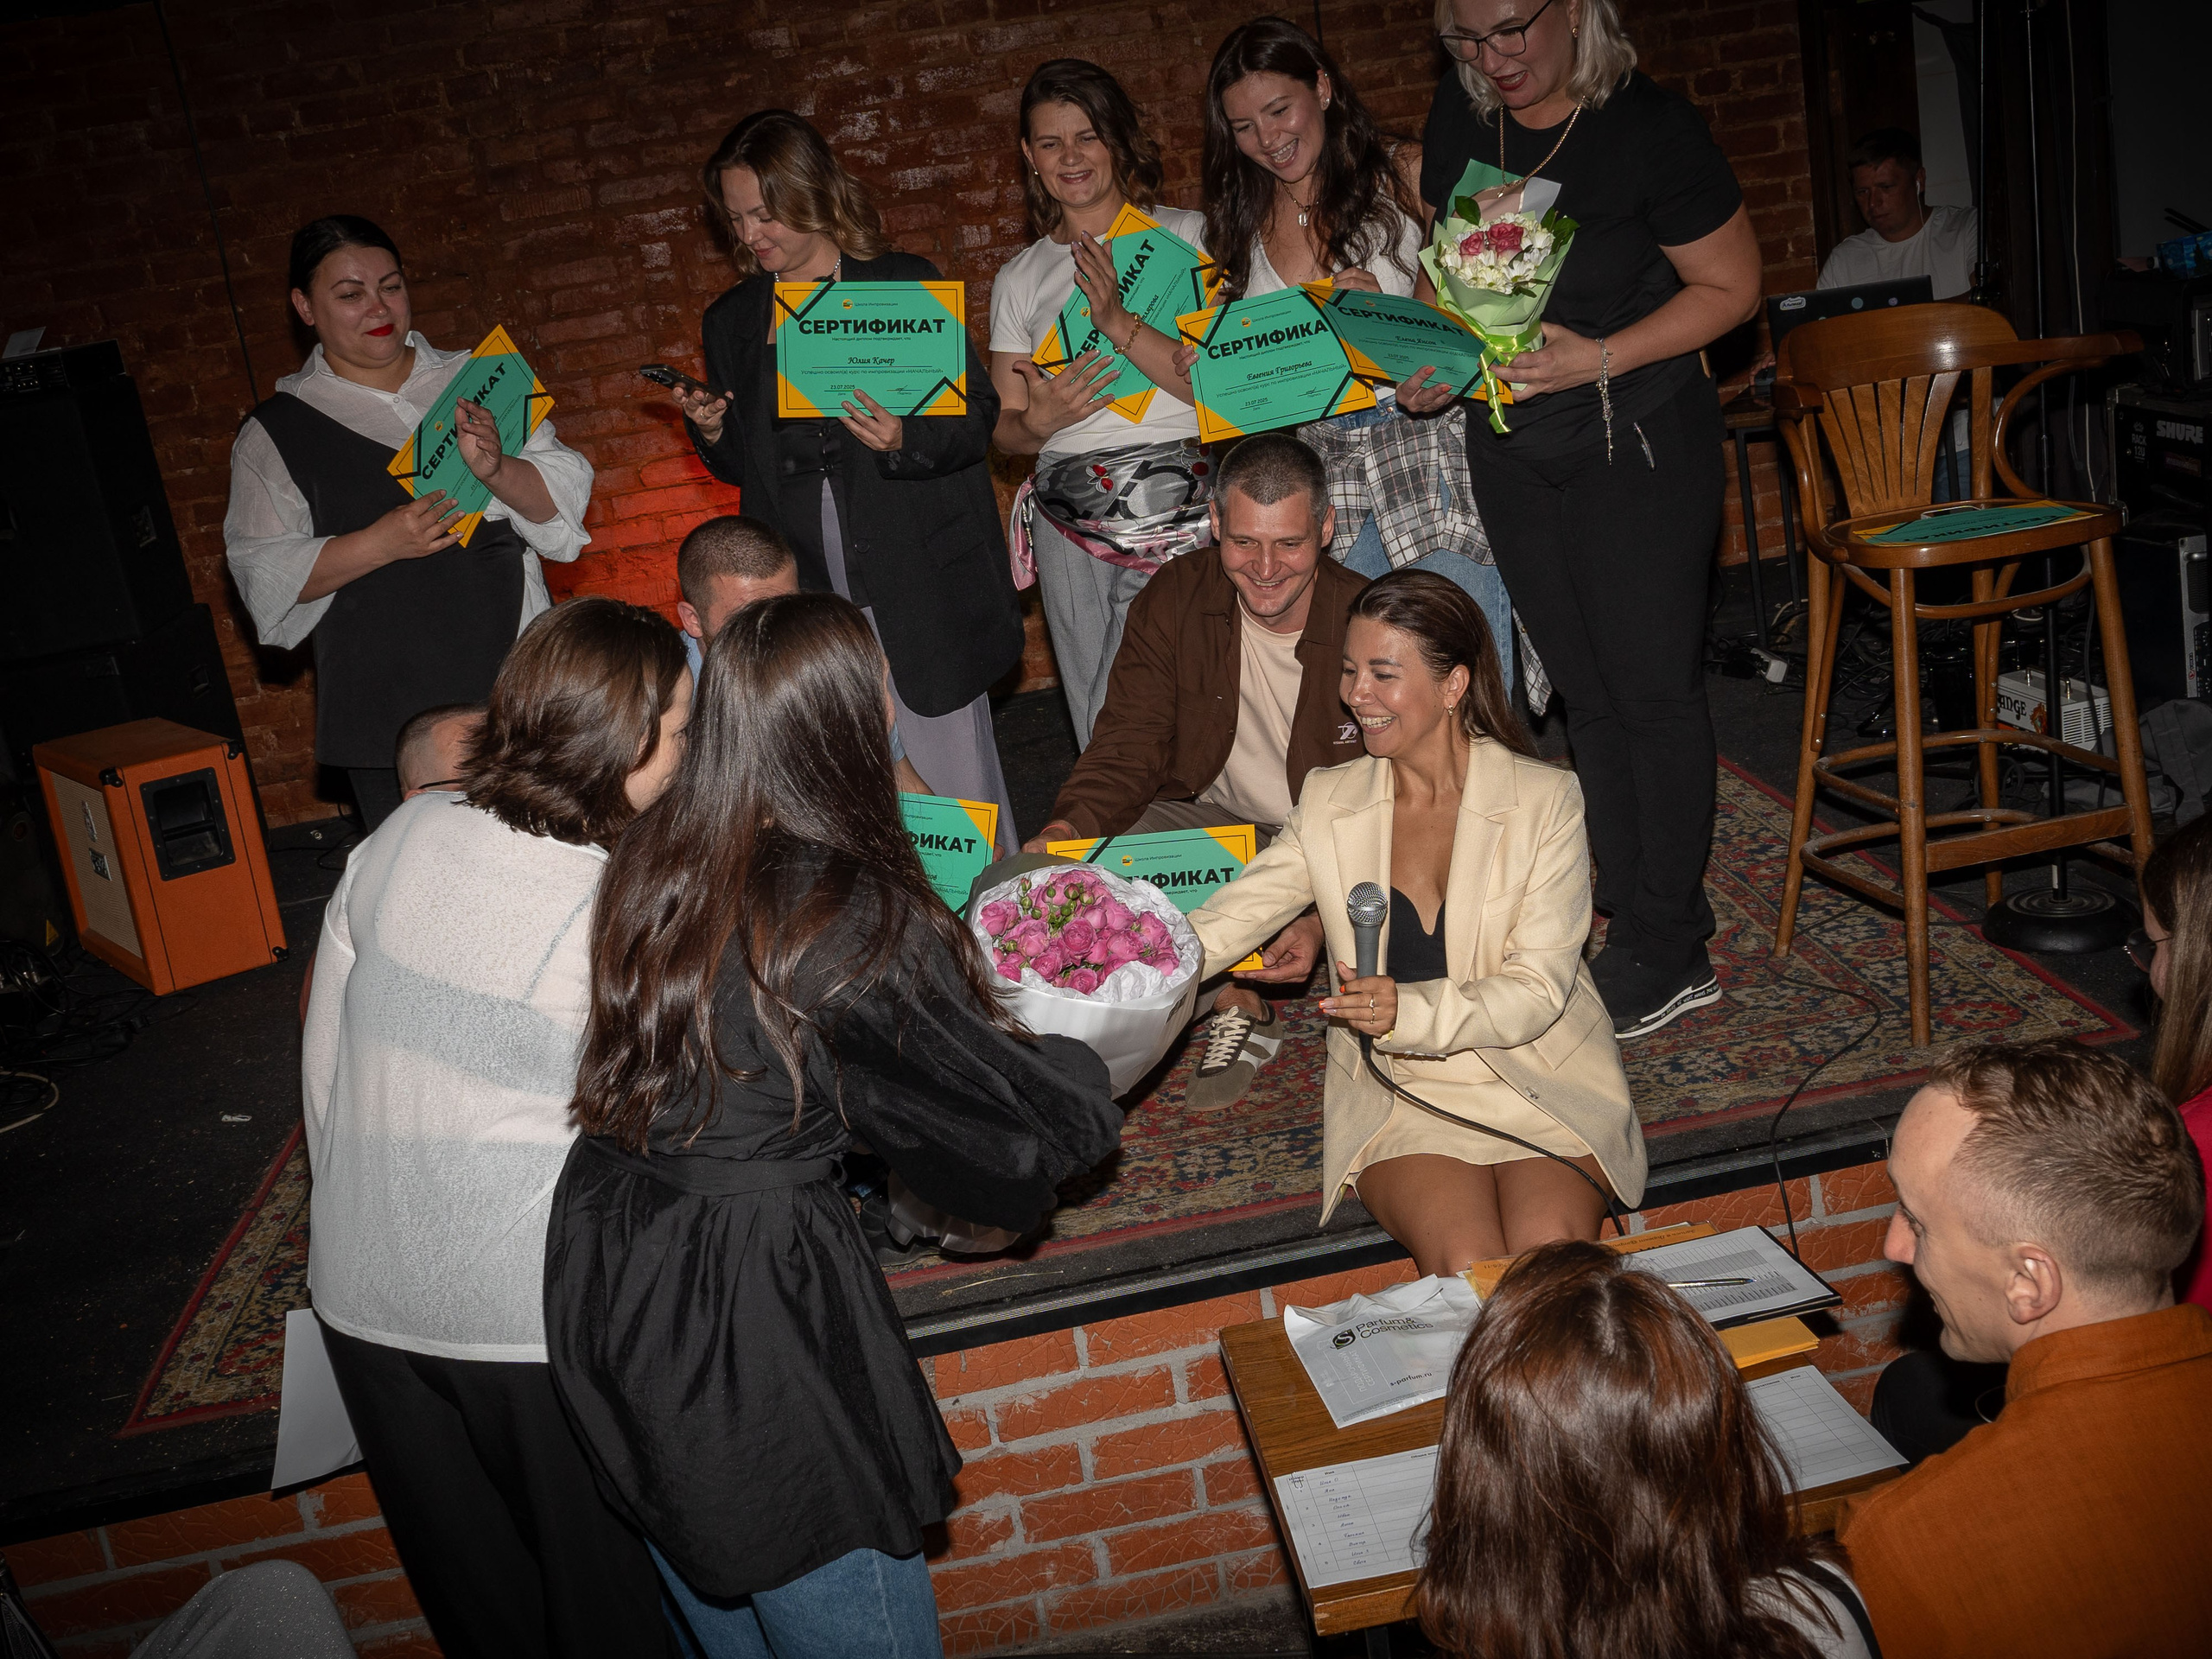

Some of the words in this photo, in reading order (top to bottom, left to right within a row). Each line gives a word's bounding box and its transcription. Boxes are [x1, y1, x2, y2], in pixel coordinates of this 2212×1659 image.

[798, 319, 946, 334] СЕРТИФИКАТ
[1338, 307, 1465, 336] СЕРТИФИКАТ
[1207, 320, 1329, 359] СЕРТИФИКА
[873, 357, 895, 366] Качер
[1246, 370, 1274, 381] Евгения
[1274, 360, 1313, 375] Григорьева
[2132, 433, 2148, 446] RACK
[2156, 420, 2204, 445] SHURE
[1998, 694, 2027, 721] ANGE
[909, 831, 977, 854] ФИКАТ
[1356, 1318, 1417, 1332] Parfum&
[1360, 1323, 1433, 1338] Cosmetics
[1338, 1351, 1367, 1393] ПОДАРОЧНЫЙ
[1349, 1350, 1376, 1387] СЕРТИФИКАТ
[1389, 1372, 1433, 1386] s-parfum.ru
